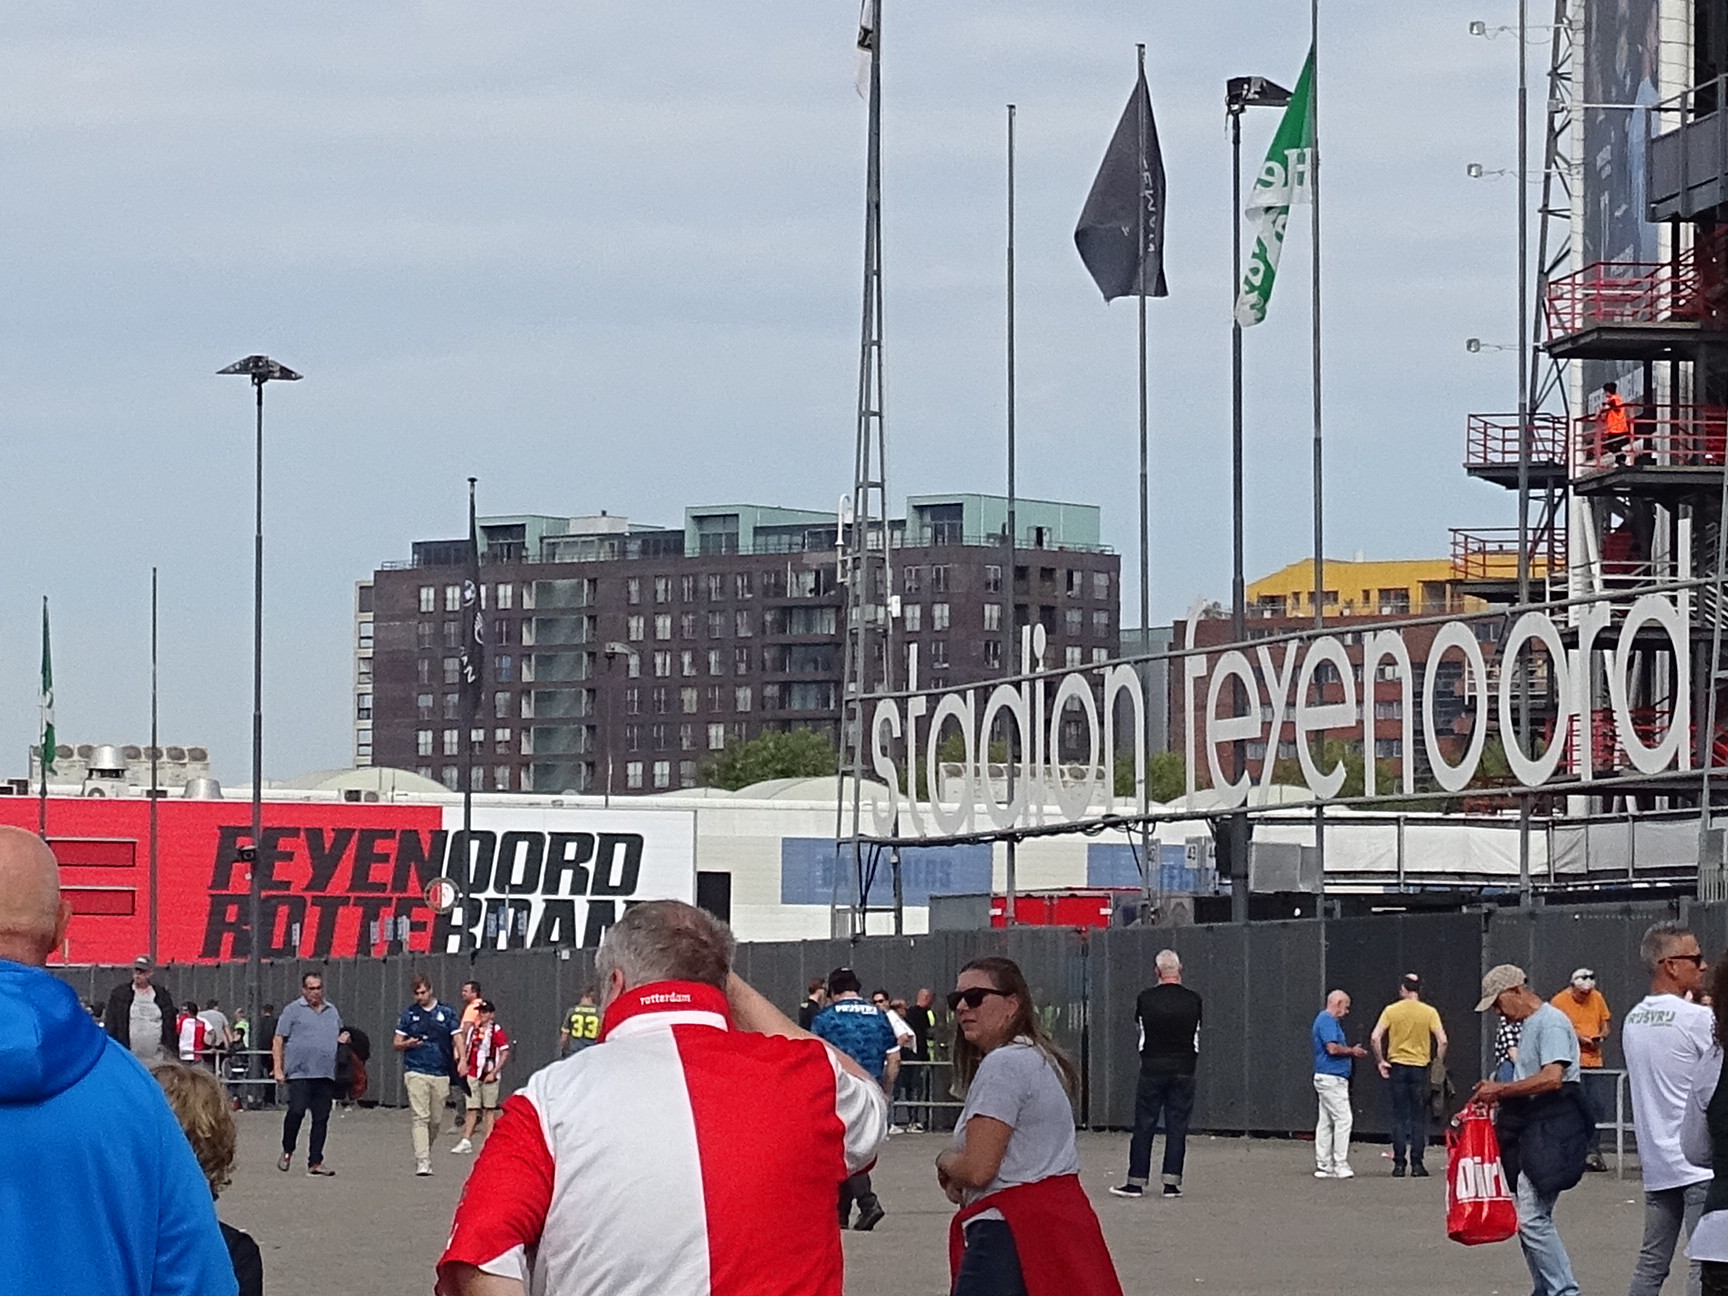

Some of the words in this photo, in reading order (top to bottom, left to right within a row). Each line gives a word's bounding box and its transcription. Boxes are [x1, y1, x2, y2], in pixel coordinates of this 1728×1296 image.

[871, 623, 1148, 838] stadion
[1183, 584, 1692, 811] feyenoord
[207, 825, 644, 896] FEYENOORD
[1186, 845, 1197, 861] 43
[639, 992, 691, 1006] rotterdam
[571, 1014, 599, 1039] 33
